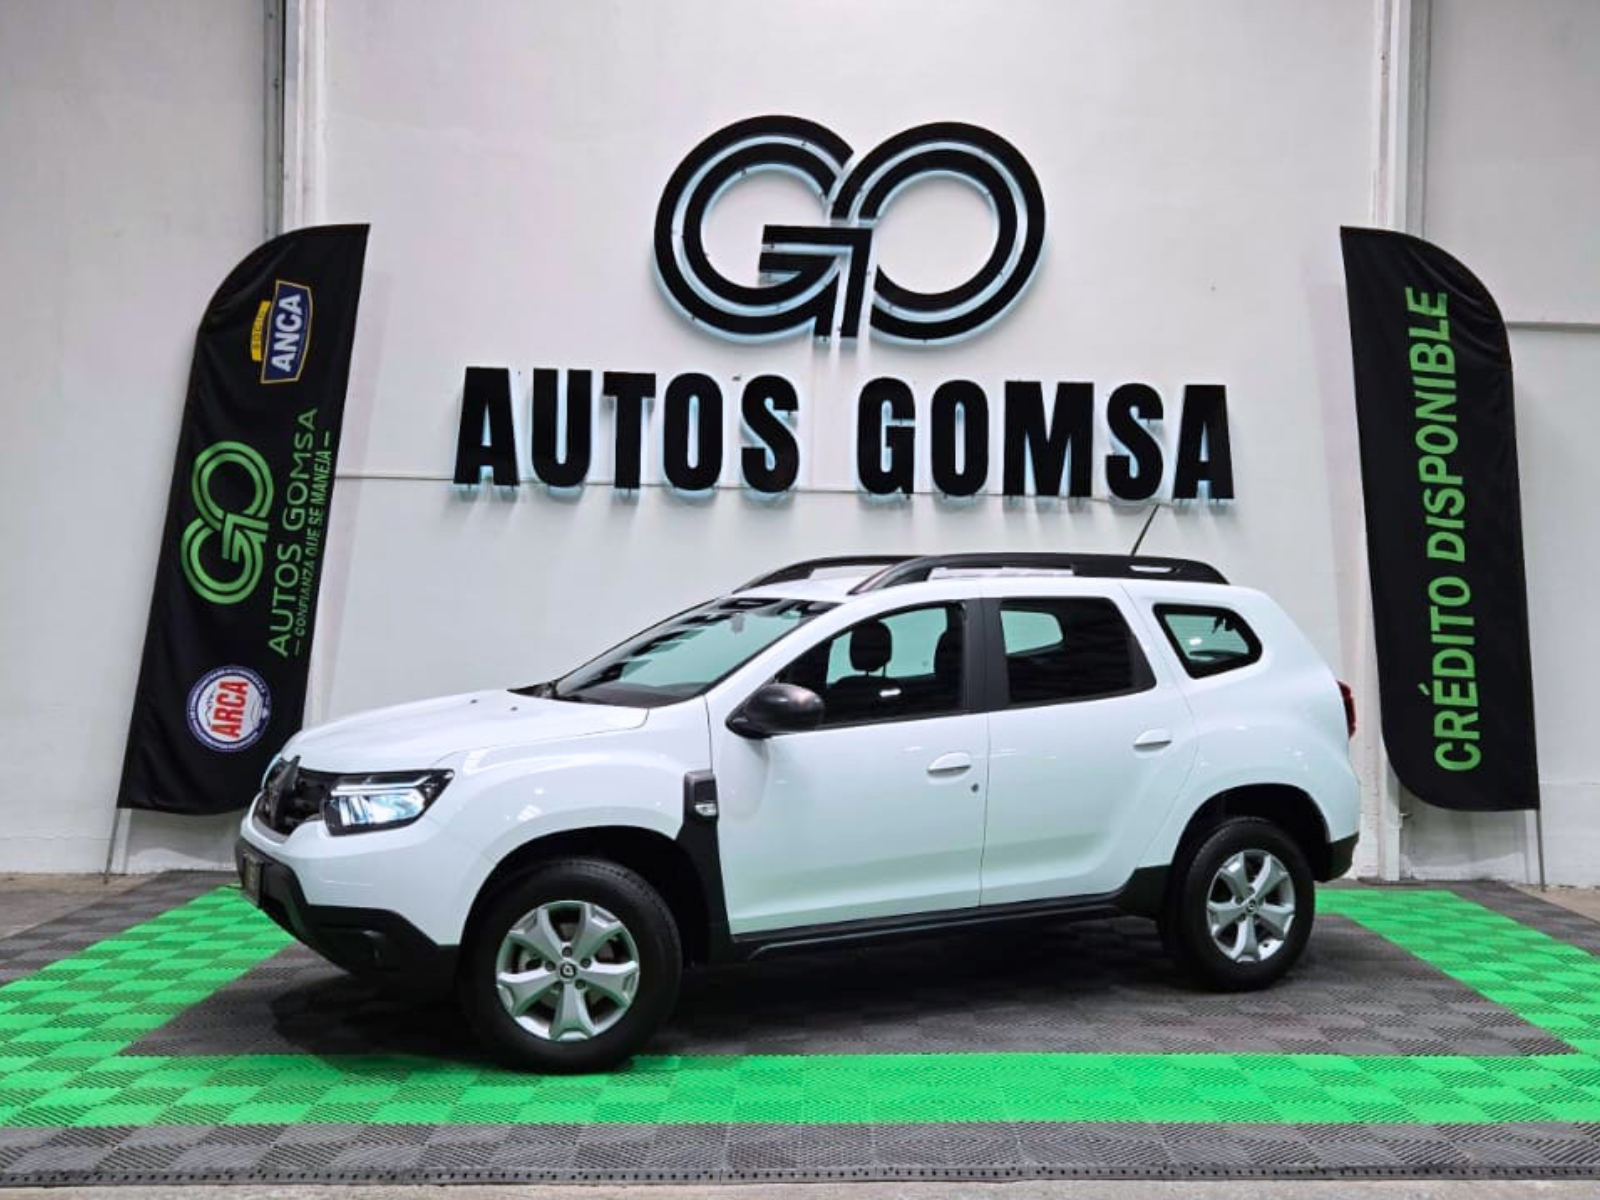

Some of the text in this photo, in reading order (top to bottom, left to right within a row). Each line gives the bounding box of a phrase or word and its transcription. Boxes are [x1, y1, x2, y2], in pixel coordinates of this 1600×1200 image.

[271, 294, 302, 372] ANCA
[453, 367, 1234, 500] AUTOS GOMSA
[268, 408, 318, 657] AUTOS GOMSA
[294, 451, 331, 636] CONFIANZA QUE SE MANEJA
[1405, 286, 1482, 772] CRÉDITO DISPONIBLE
[211, 681, 249, 738] ARCA
